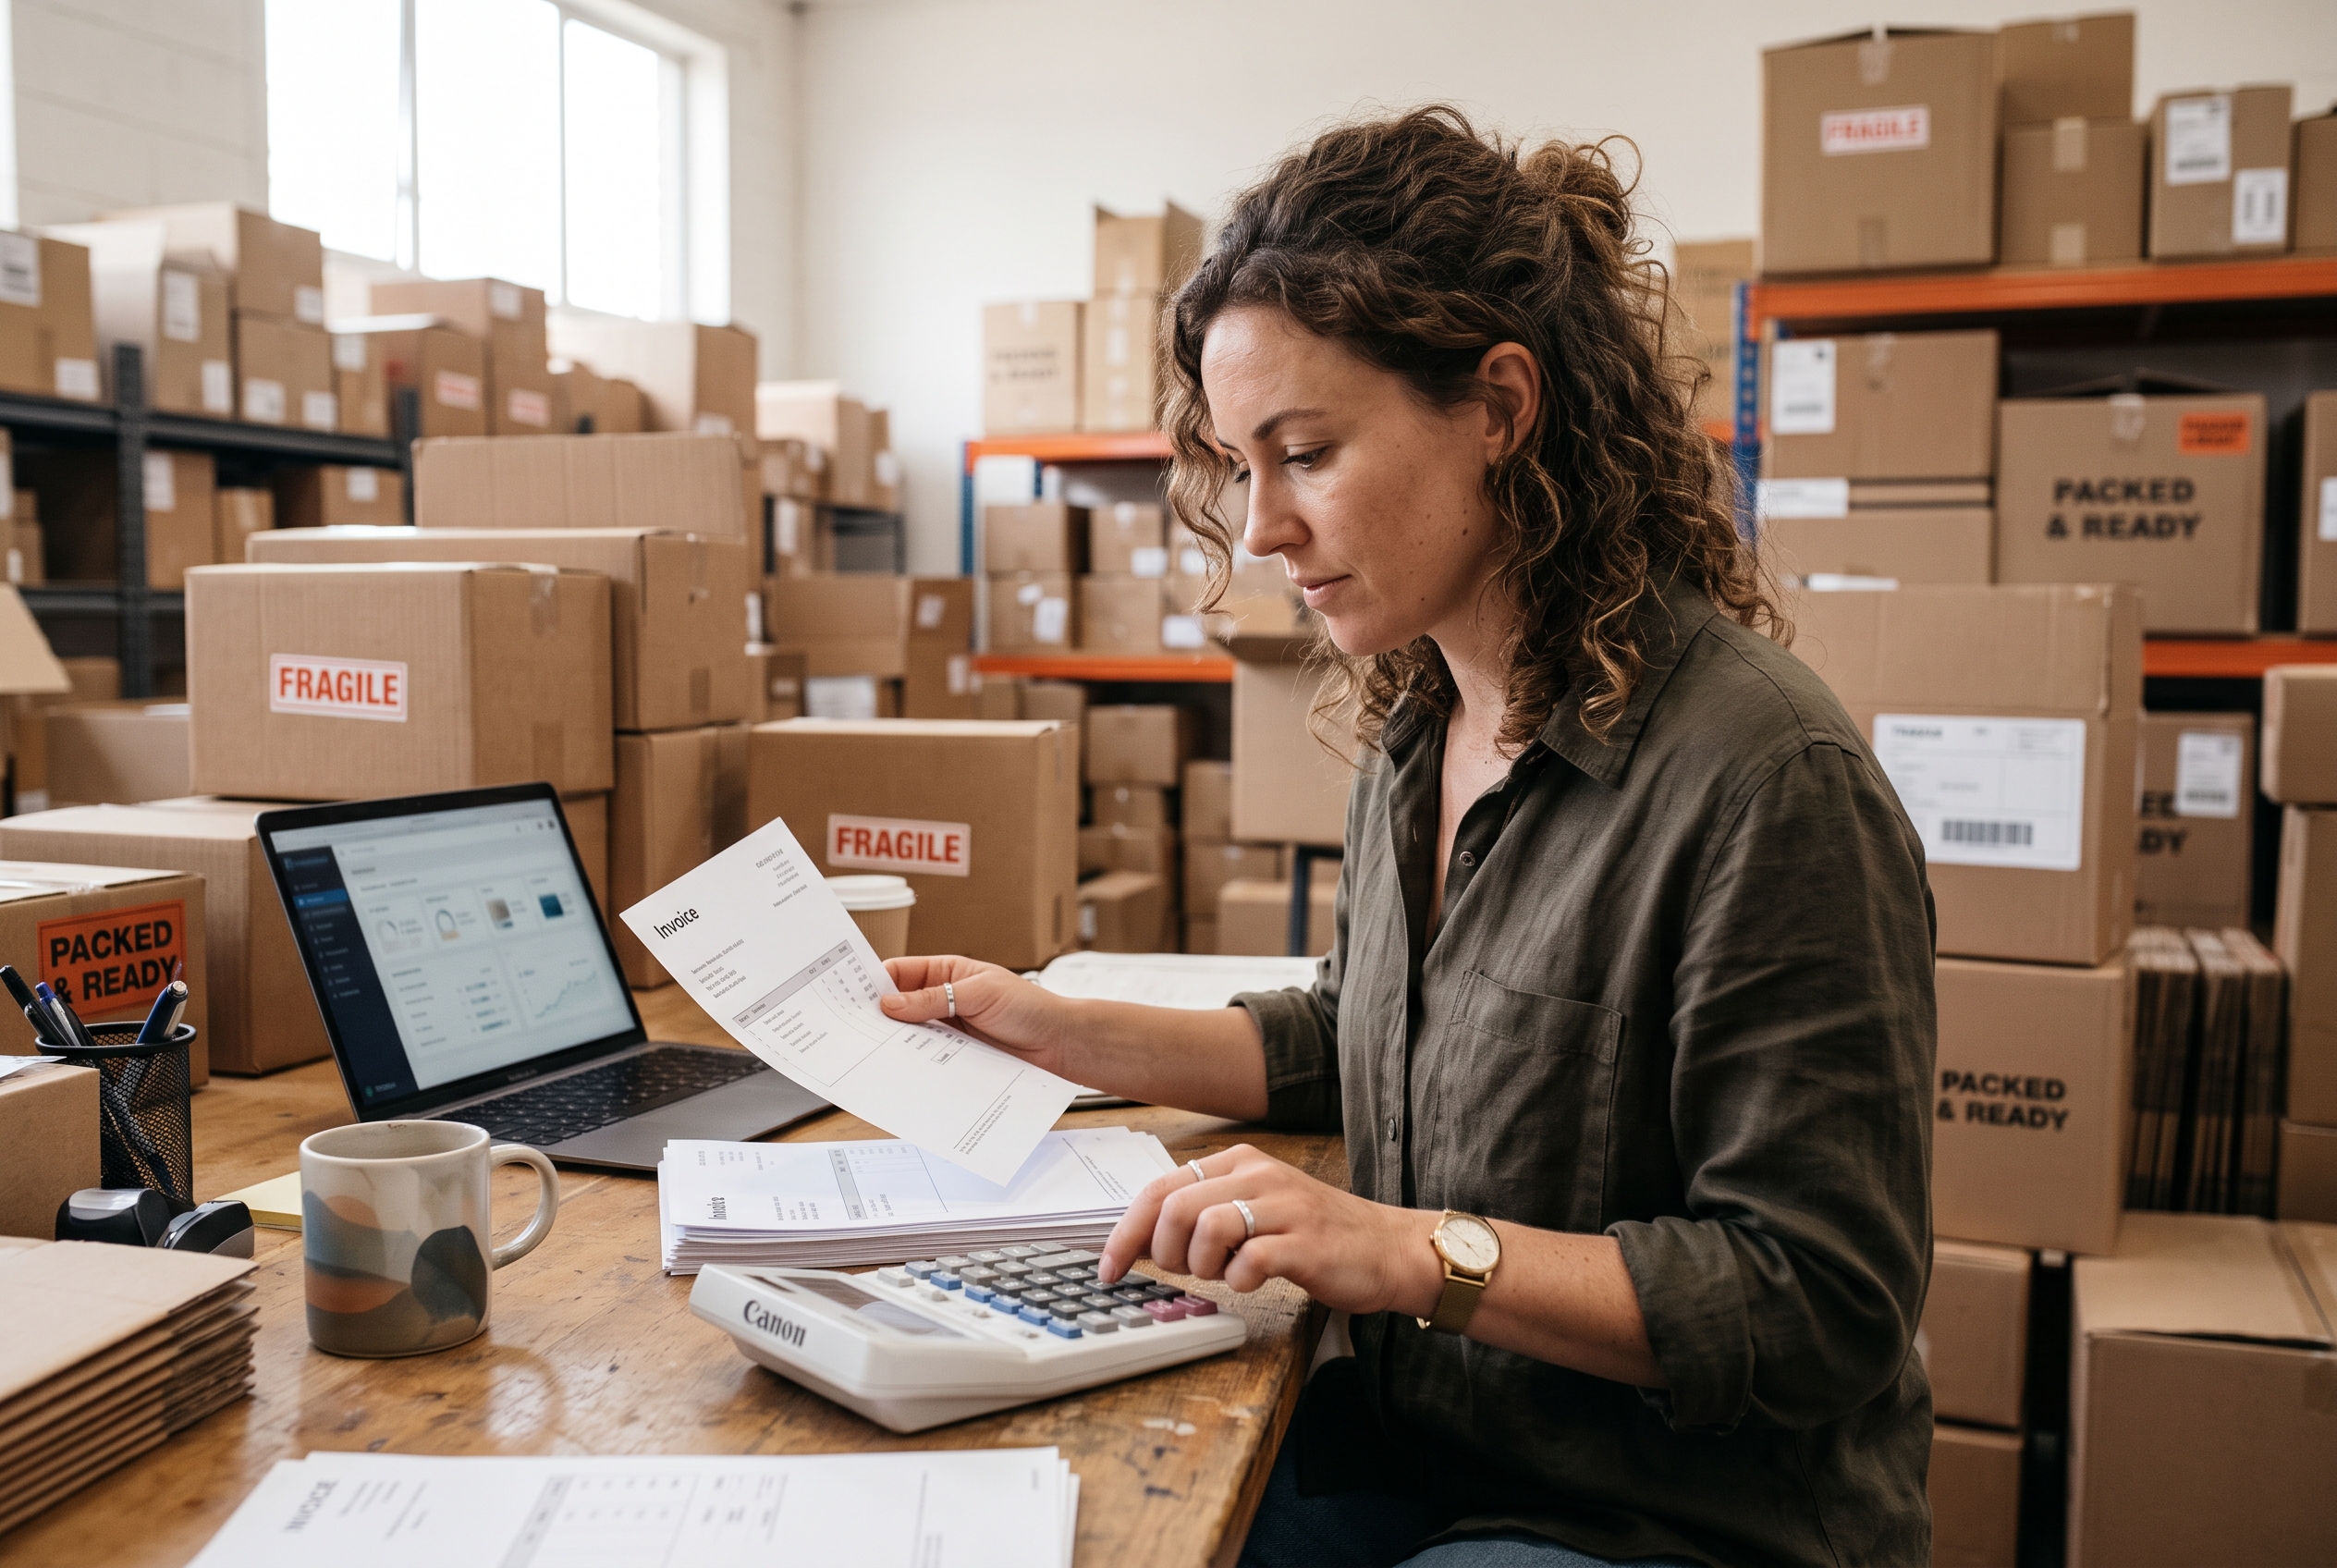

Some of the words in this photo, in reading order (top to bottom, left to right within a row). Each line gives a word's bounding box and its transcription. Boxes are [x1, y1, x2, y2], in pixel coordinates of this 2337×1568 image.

[2053, 478, 2196, 504] PACKED
[2082, 512, 2202, 542] READY
[280, 667, 398, 705] FRAGILE
[837, 827, 960, 864] FRAGILE
[653, 908, 700, 939] Invoice
[50, 919, 173, 968] PACKED
[54, 976, 73, 1004] &
[82, 954, 177, 1001] READY
[1941, 1070, 2066, 1102] PACKED
[1937, 1097, 1954, 1121] &
[1965, 1100, 2069, 1133] READY
[743, 1299, 807, 1348] Canon
